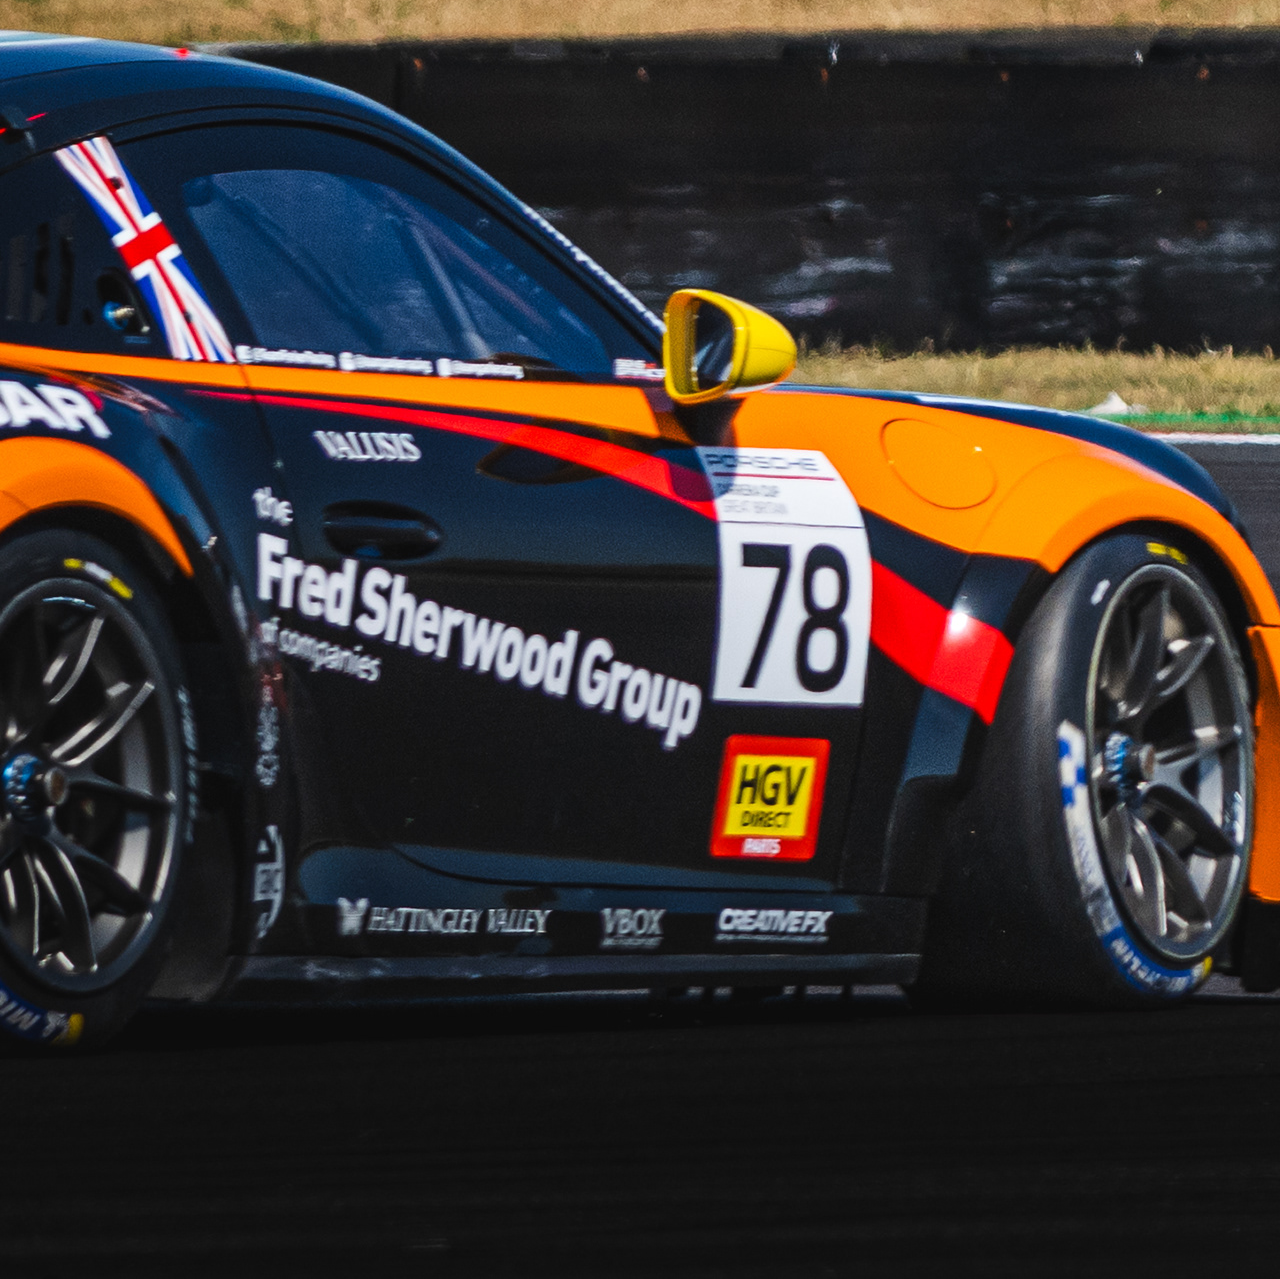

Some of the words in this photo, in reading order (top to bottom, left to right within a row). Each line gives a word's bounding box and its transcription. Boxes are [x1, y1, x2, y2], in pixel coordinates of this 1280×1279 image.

[0, 380, 112, 439] AR
[704, 453, 819, 472] PORSCHE
[253, 486, 294, 527] the
[740, 542, 850, 693] 78
[257, 532, 360, 627] Fred
[355, 566, 580, 698] Sherwood
[578, 638, 702, 750] Group
[278, 628, 382, 682] companies
[735, 764, 808, 806] HGV
[741, 810, 791, 828] DIRECT
[601, 908, 667, 935] VBOX
